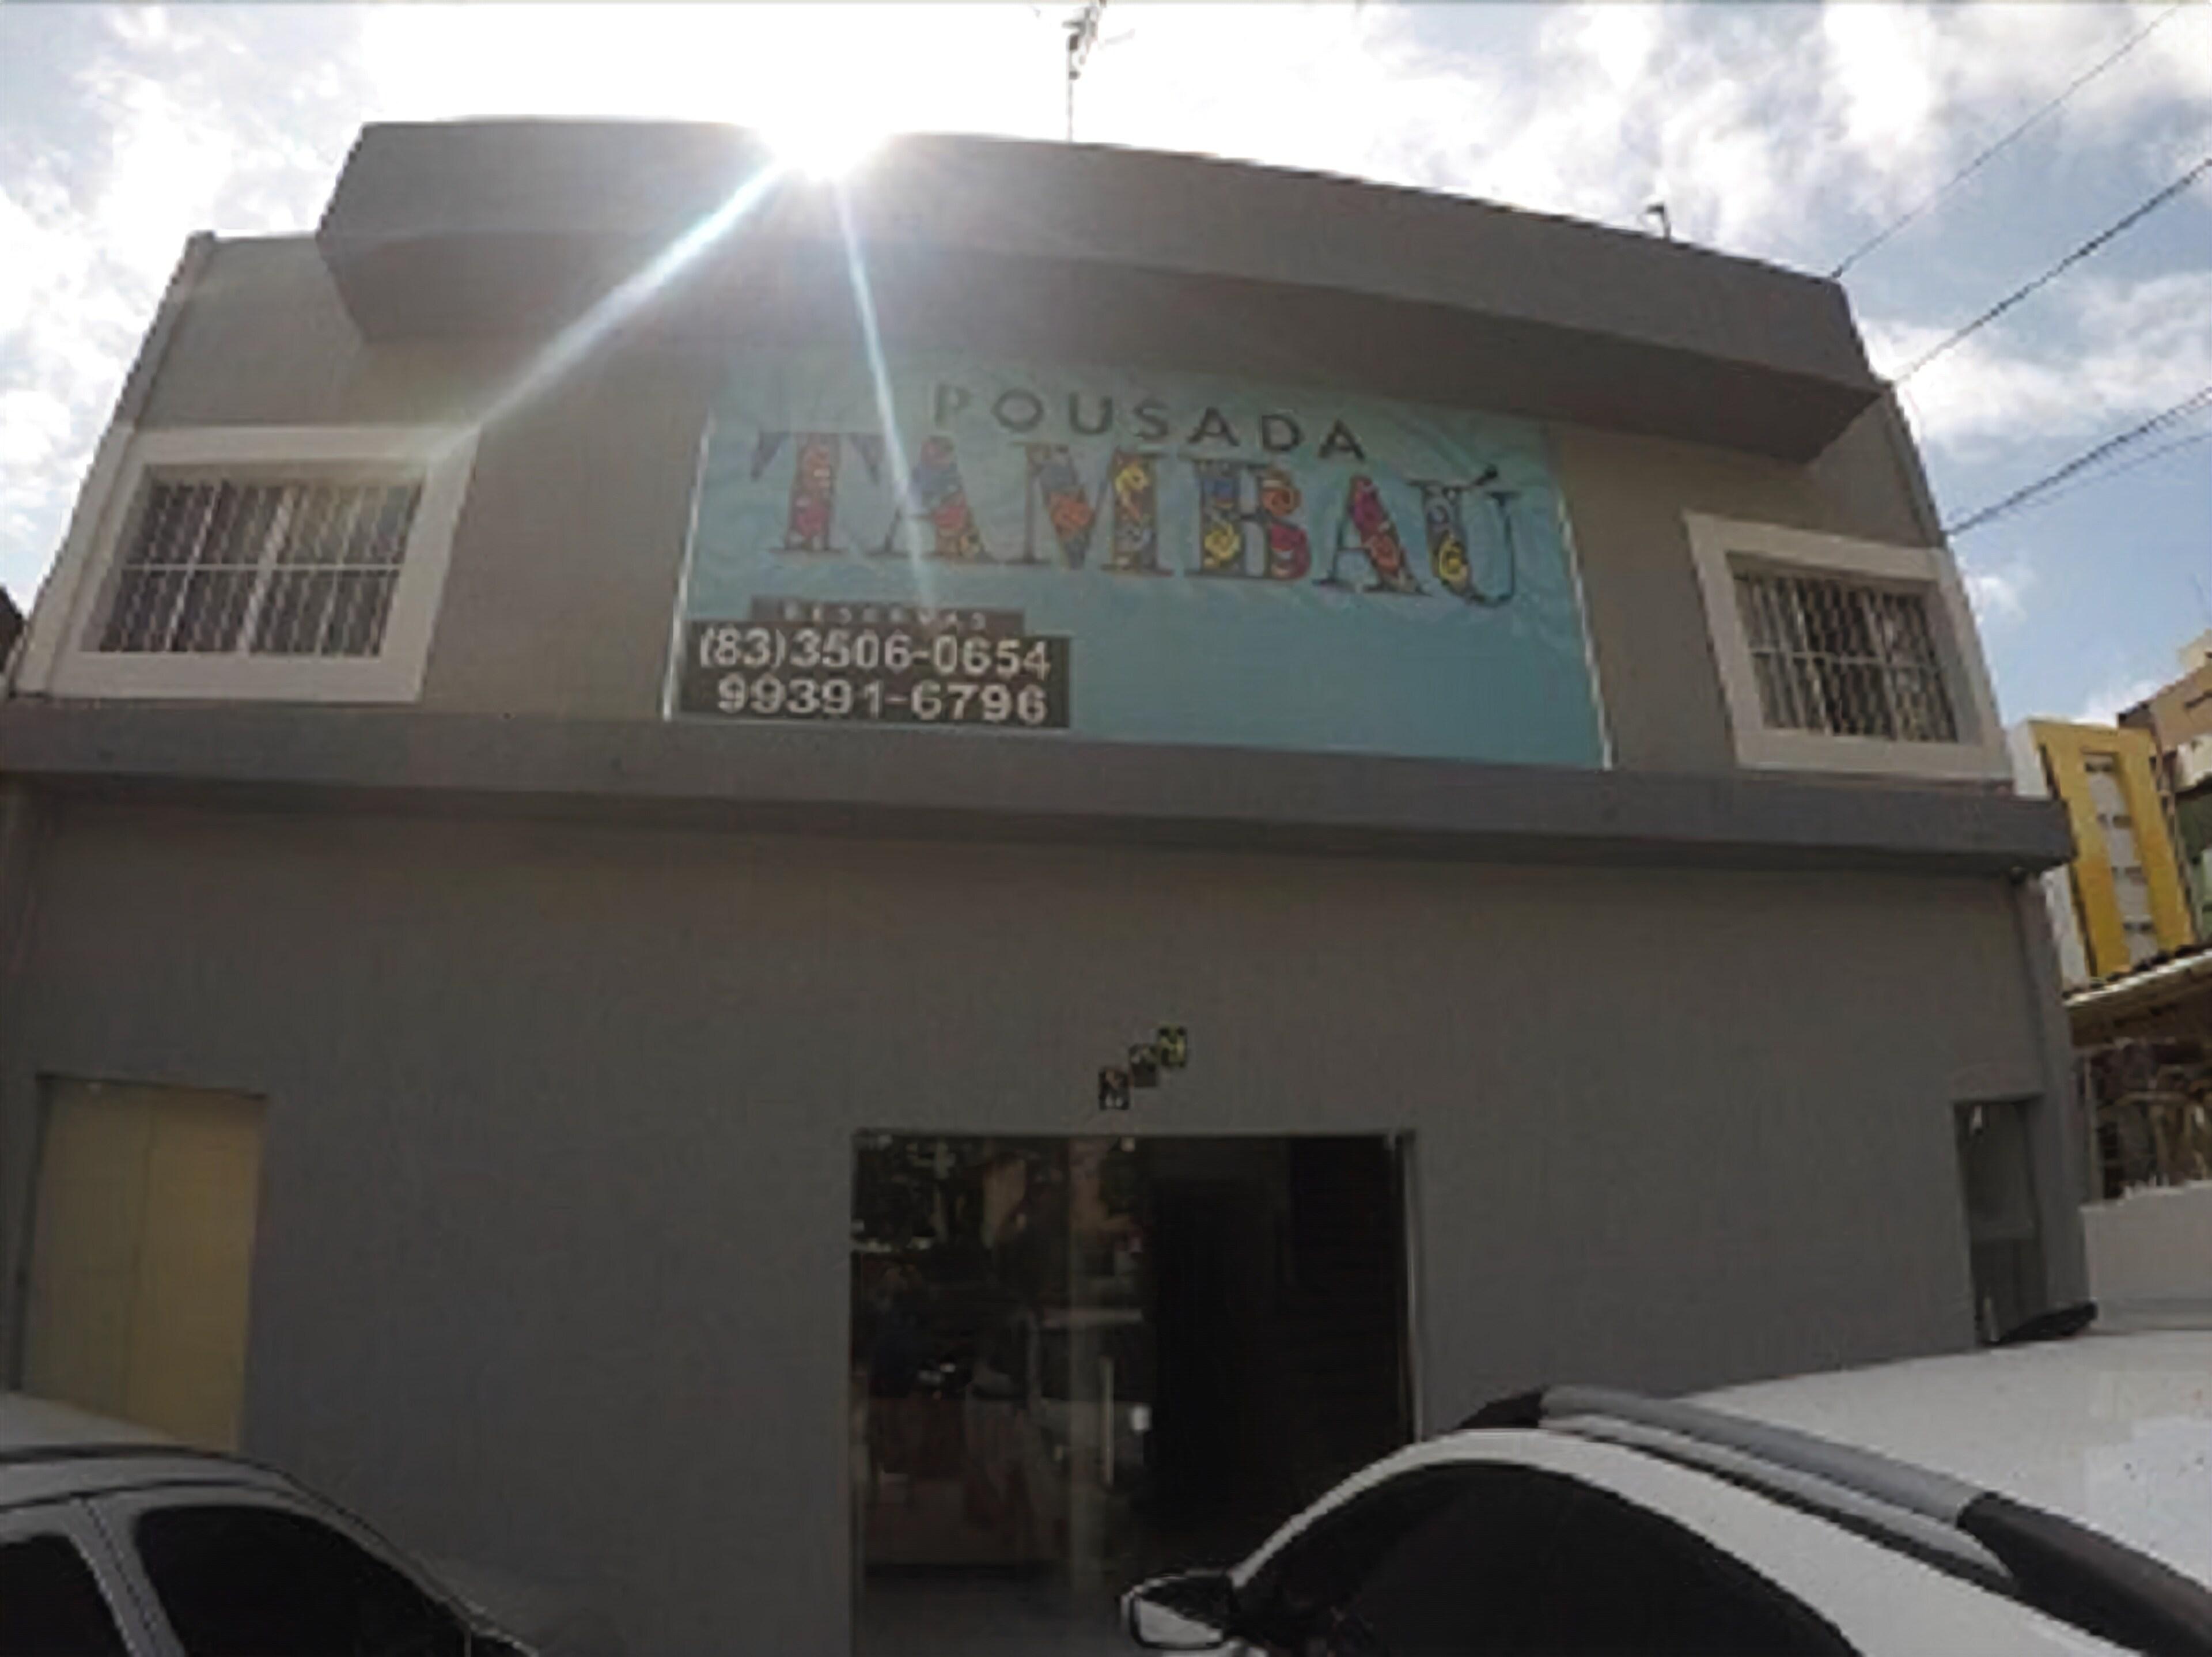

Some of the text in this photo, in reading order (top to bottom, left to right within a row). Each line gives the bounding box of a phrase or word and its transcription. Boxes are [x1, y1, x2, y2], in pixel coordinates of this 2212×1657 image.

[934, 385, 1366, 461] POUSADA
[750, 431, 1521, 607] TAMBAÚ
[718, 672, 1047, 725] 99391-6796
